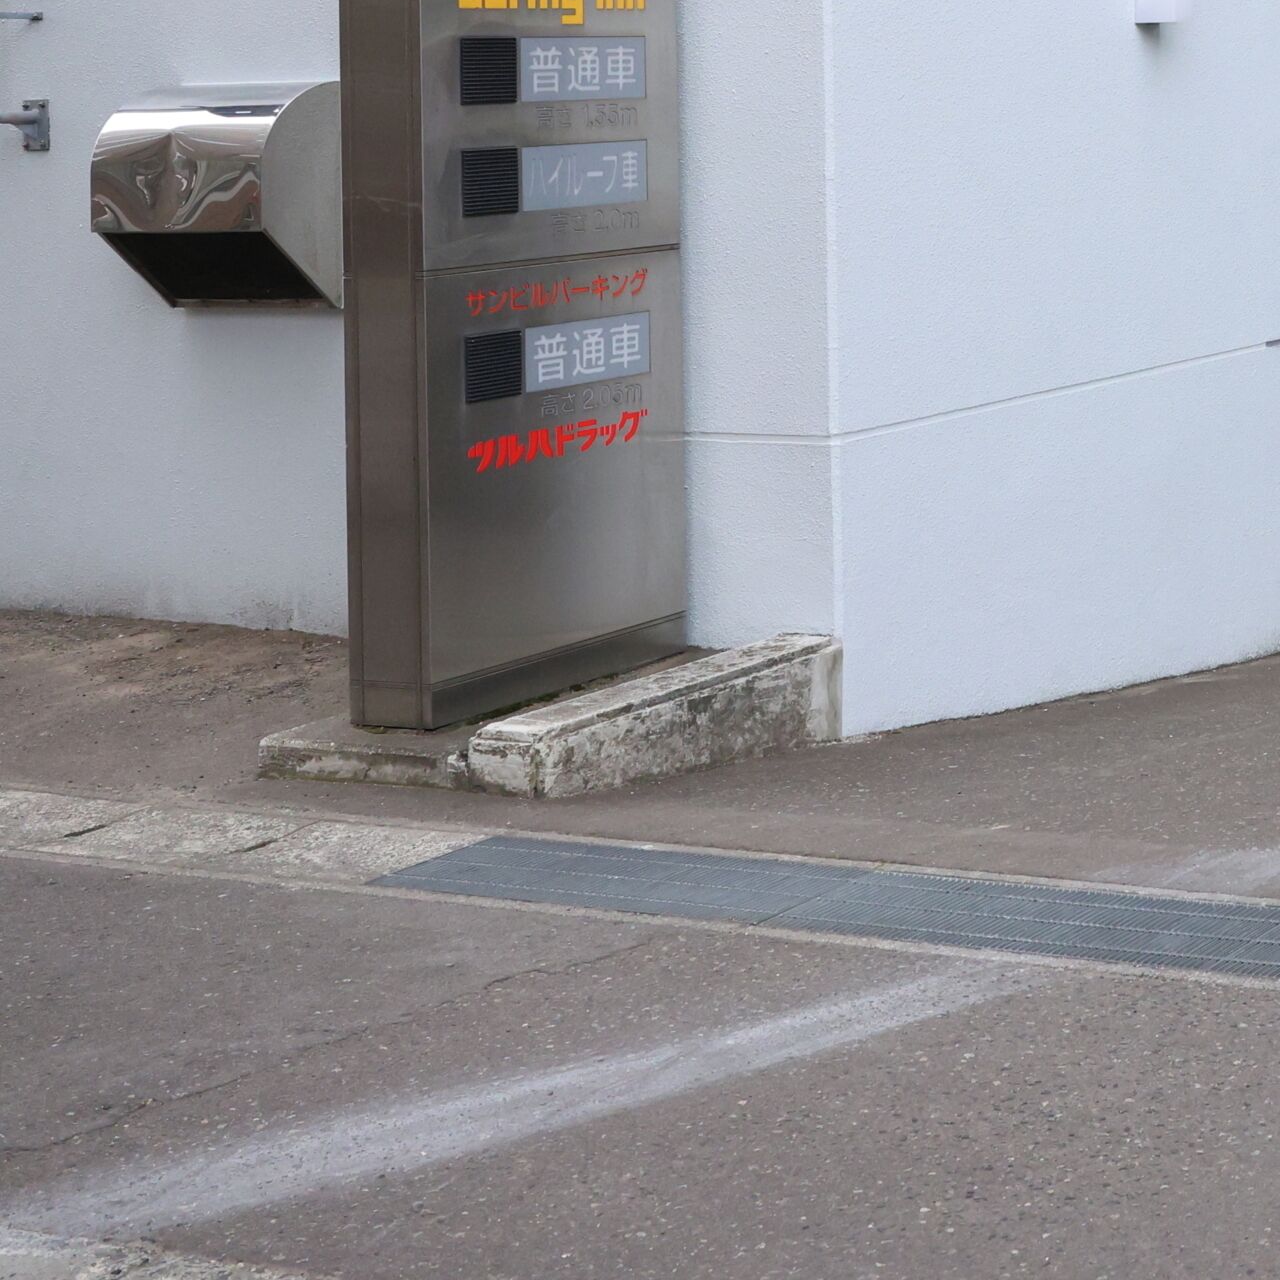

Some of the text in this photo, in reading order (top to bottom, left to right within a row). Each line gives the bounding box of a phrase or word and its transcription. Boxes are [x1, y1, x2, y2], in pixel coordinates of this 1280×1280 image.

[528, 45, 637, 94] 普通車
[528, 150, 639, 198] ハイルーフ車
[466, 267, 648, 316] サンビルパーキング
[533, 322, 641, 384] 普通車
[541, 393, 576, 417] 高さ
[466, 409, 648, 473] ツルハドラッグ
